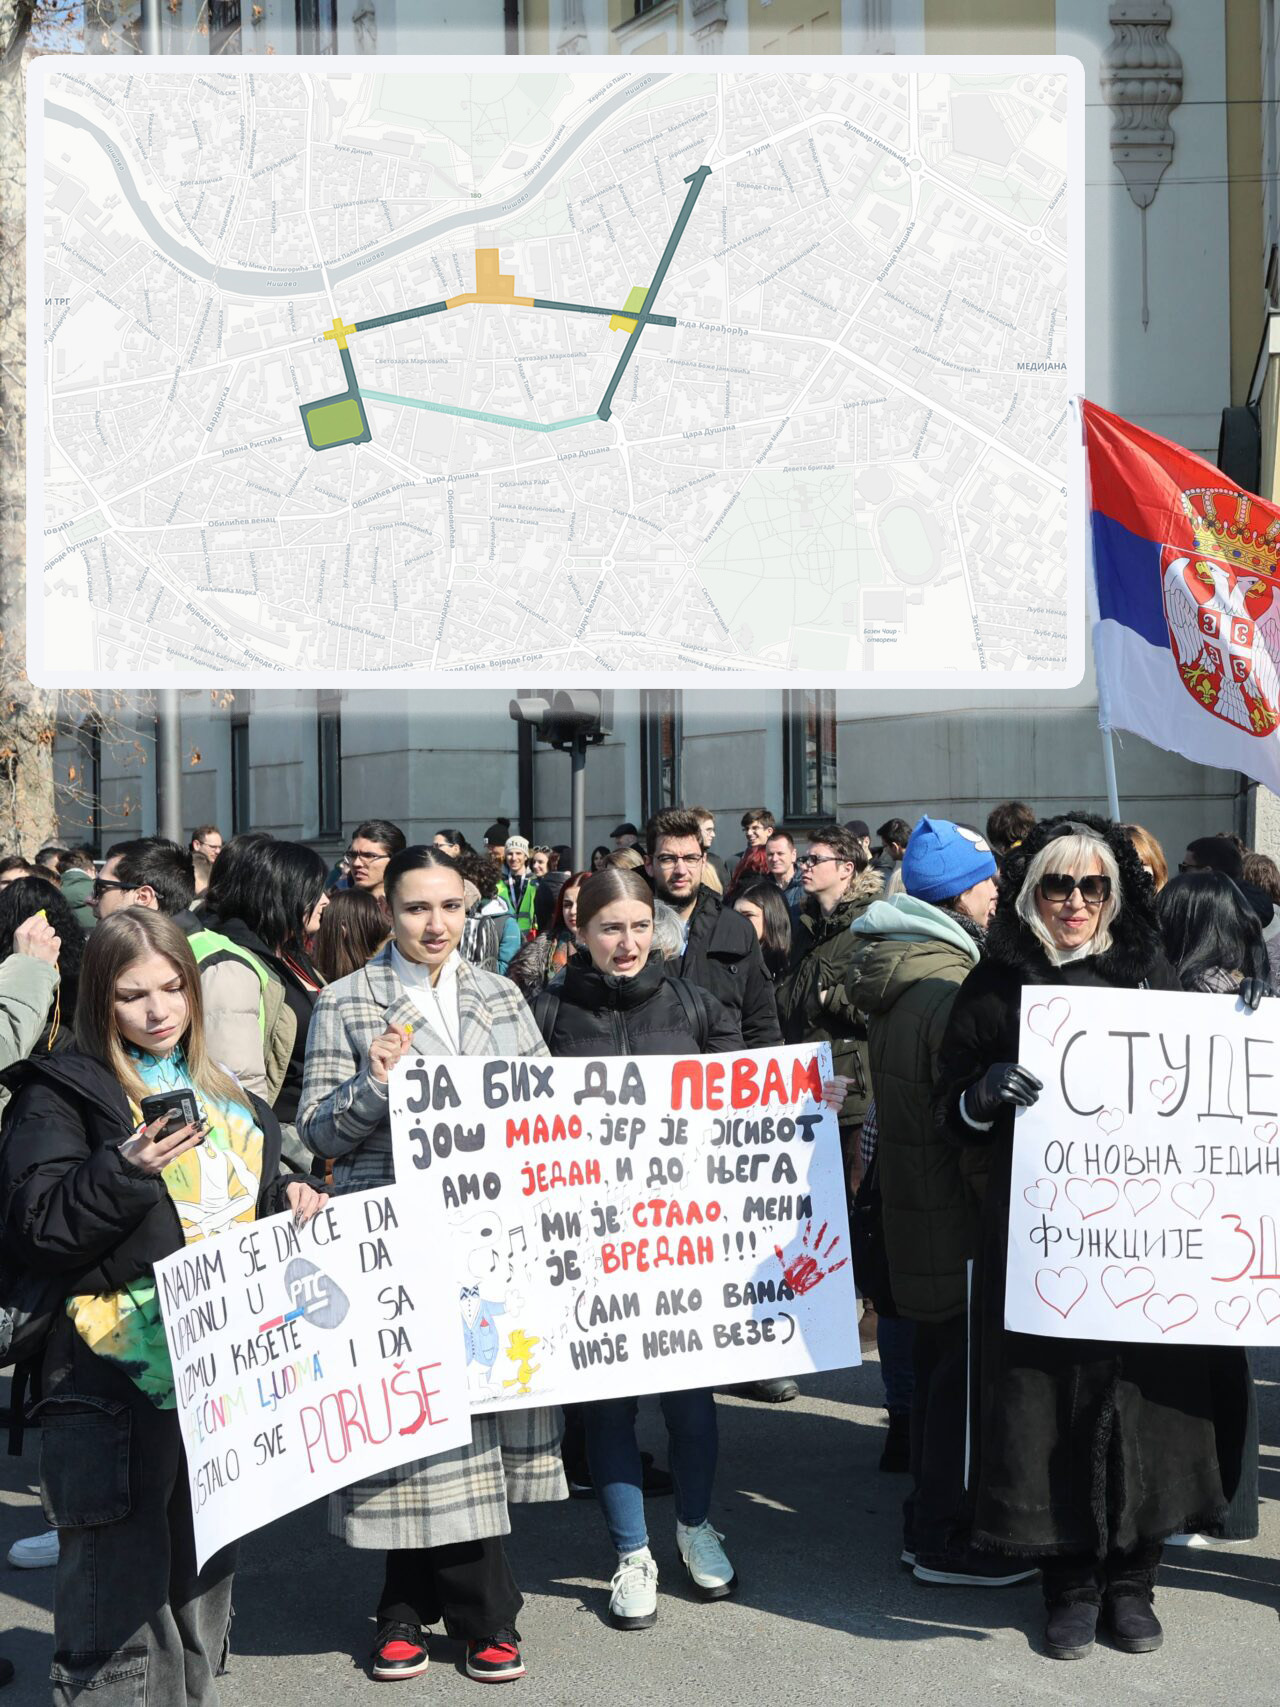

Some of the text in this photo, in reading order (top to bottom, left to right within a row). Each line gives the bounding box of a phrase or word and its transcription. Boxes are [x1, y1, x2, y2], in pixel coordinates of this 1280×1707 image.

[482, 1060, 555, 1108] БИХ
[573, 1061, 647, 1106] ДА
[671, 1056, 823, 1112] ПЕВАМ
[408, 1116, 486, 1170] ЈОШ
[599, 1113, 646, 1150] ЈЕР
[658, 1113, 689, 1147] ЈЕ
[710, 1114, 824, 1147] ЖИВОТ
[1044, 1140, 1182, 1177] ОСНОВНА
[442, 1171, 501, 1210] АМО
[615, 1157, 634, 1182] И
[646, 1155, 684, 1188] ДО
[707, 1152, 798, 1185] ЊЕГА
[541, 1210, 581, 1242] МИ
[592, 1200, 621, 1237] ЈЕ
[743, 1194, 813, 1223] МЕНИ
[1029, 1213, 1204, 1260] ФУНКЦИЈЕ
[163, 1250, 226, 1316] NADAM
[239, 1232, 267, 1277] SE
[273, 1222, 301, 1263] DA
[364, 1197, 399, 1233] DA
[545, 1248, 581, 1286] ЈЕ
[170, 1297, 227, 1360] UPADNU
[250, 1284, 265, 1315] U
[359, 1238, 393, 1273] DA
[574, 1279, 796, 1333] (АЛИ АКО ВАМА
[178, 1285, 414, 1410] UZMU KASETE SA
[349, 1338, 358, 1367] I
[378, 1326, 413, 1360] DA
[569, 1311, 796, 1370] НИЈЕ НЕМА ВЕЗЕ)
[193, 1361, 449, 1514] OSTALO SVE PORUŠE
